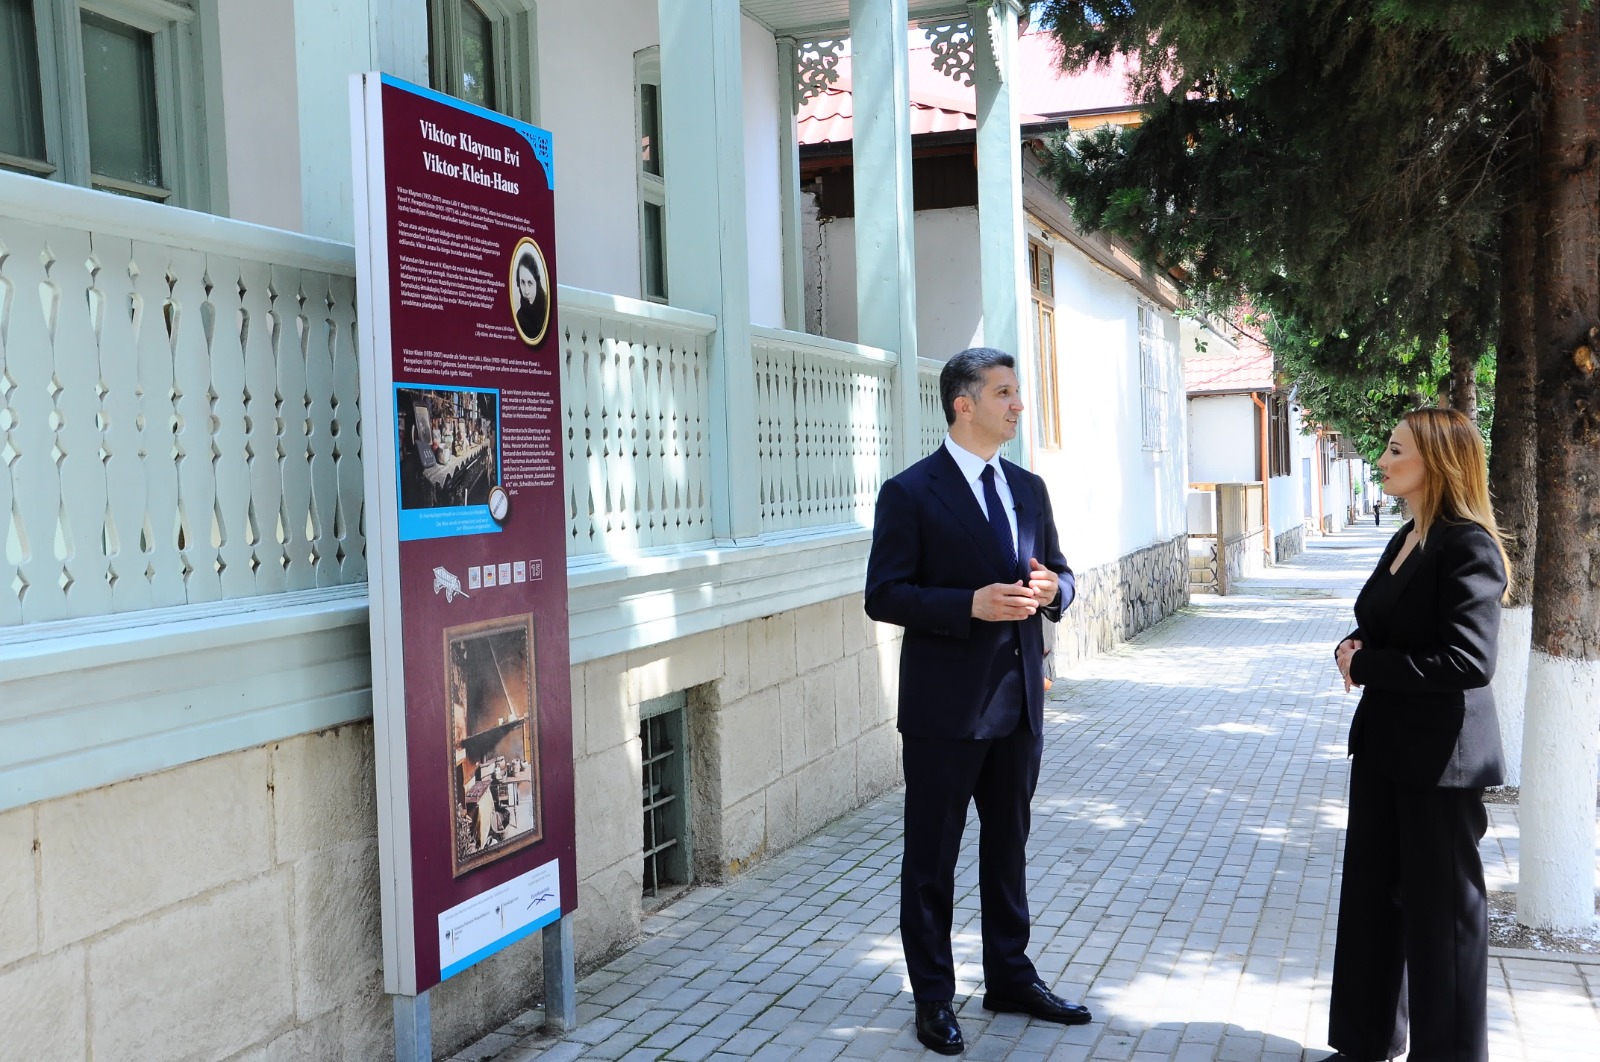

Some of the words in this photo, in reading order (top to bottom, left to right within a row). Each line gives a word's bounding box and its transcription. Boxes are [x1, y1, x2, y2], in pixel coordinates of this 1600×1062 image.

[420, 120, 457, 148] Viktor
[459, 132, 502, 162] Klaynın
[504, 146, 520, 168] Evi
[423, 151, 519, 196] Viktor-Klein-Haus
[531, 563, 540, 577] 15
